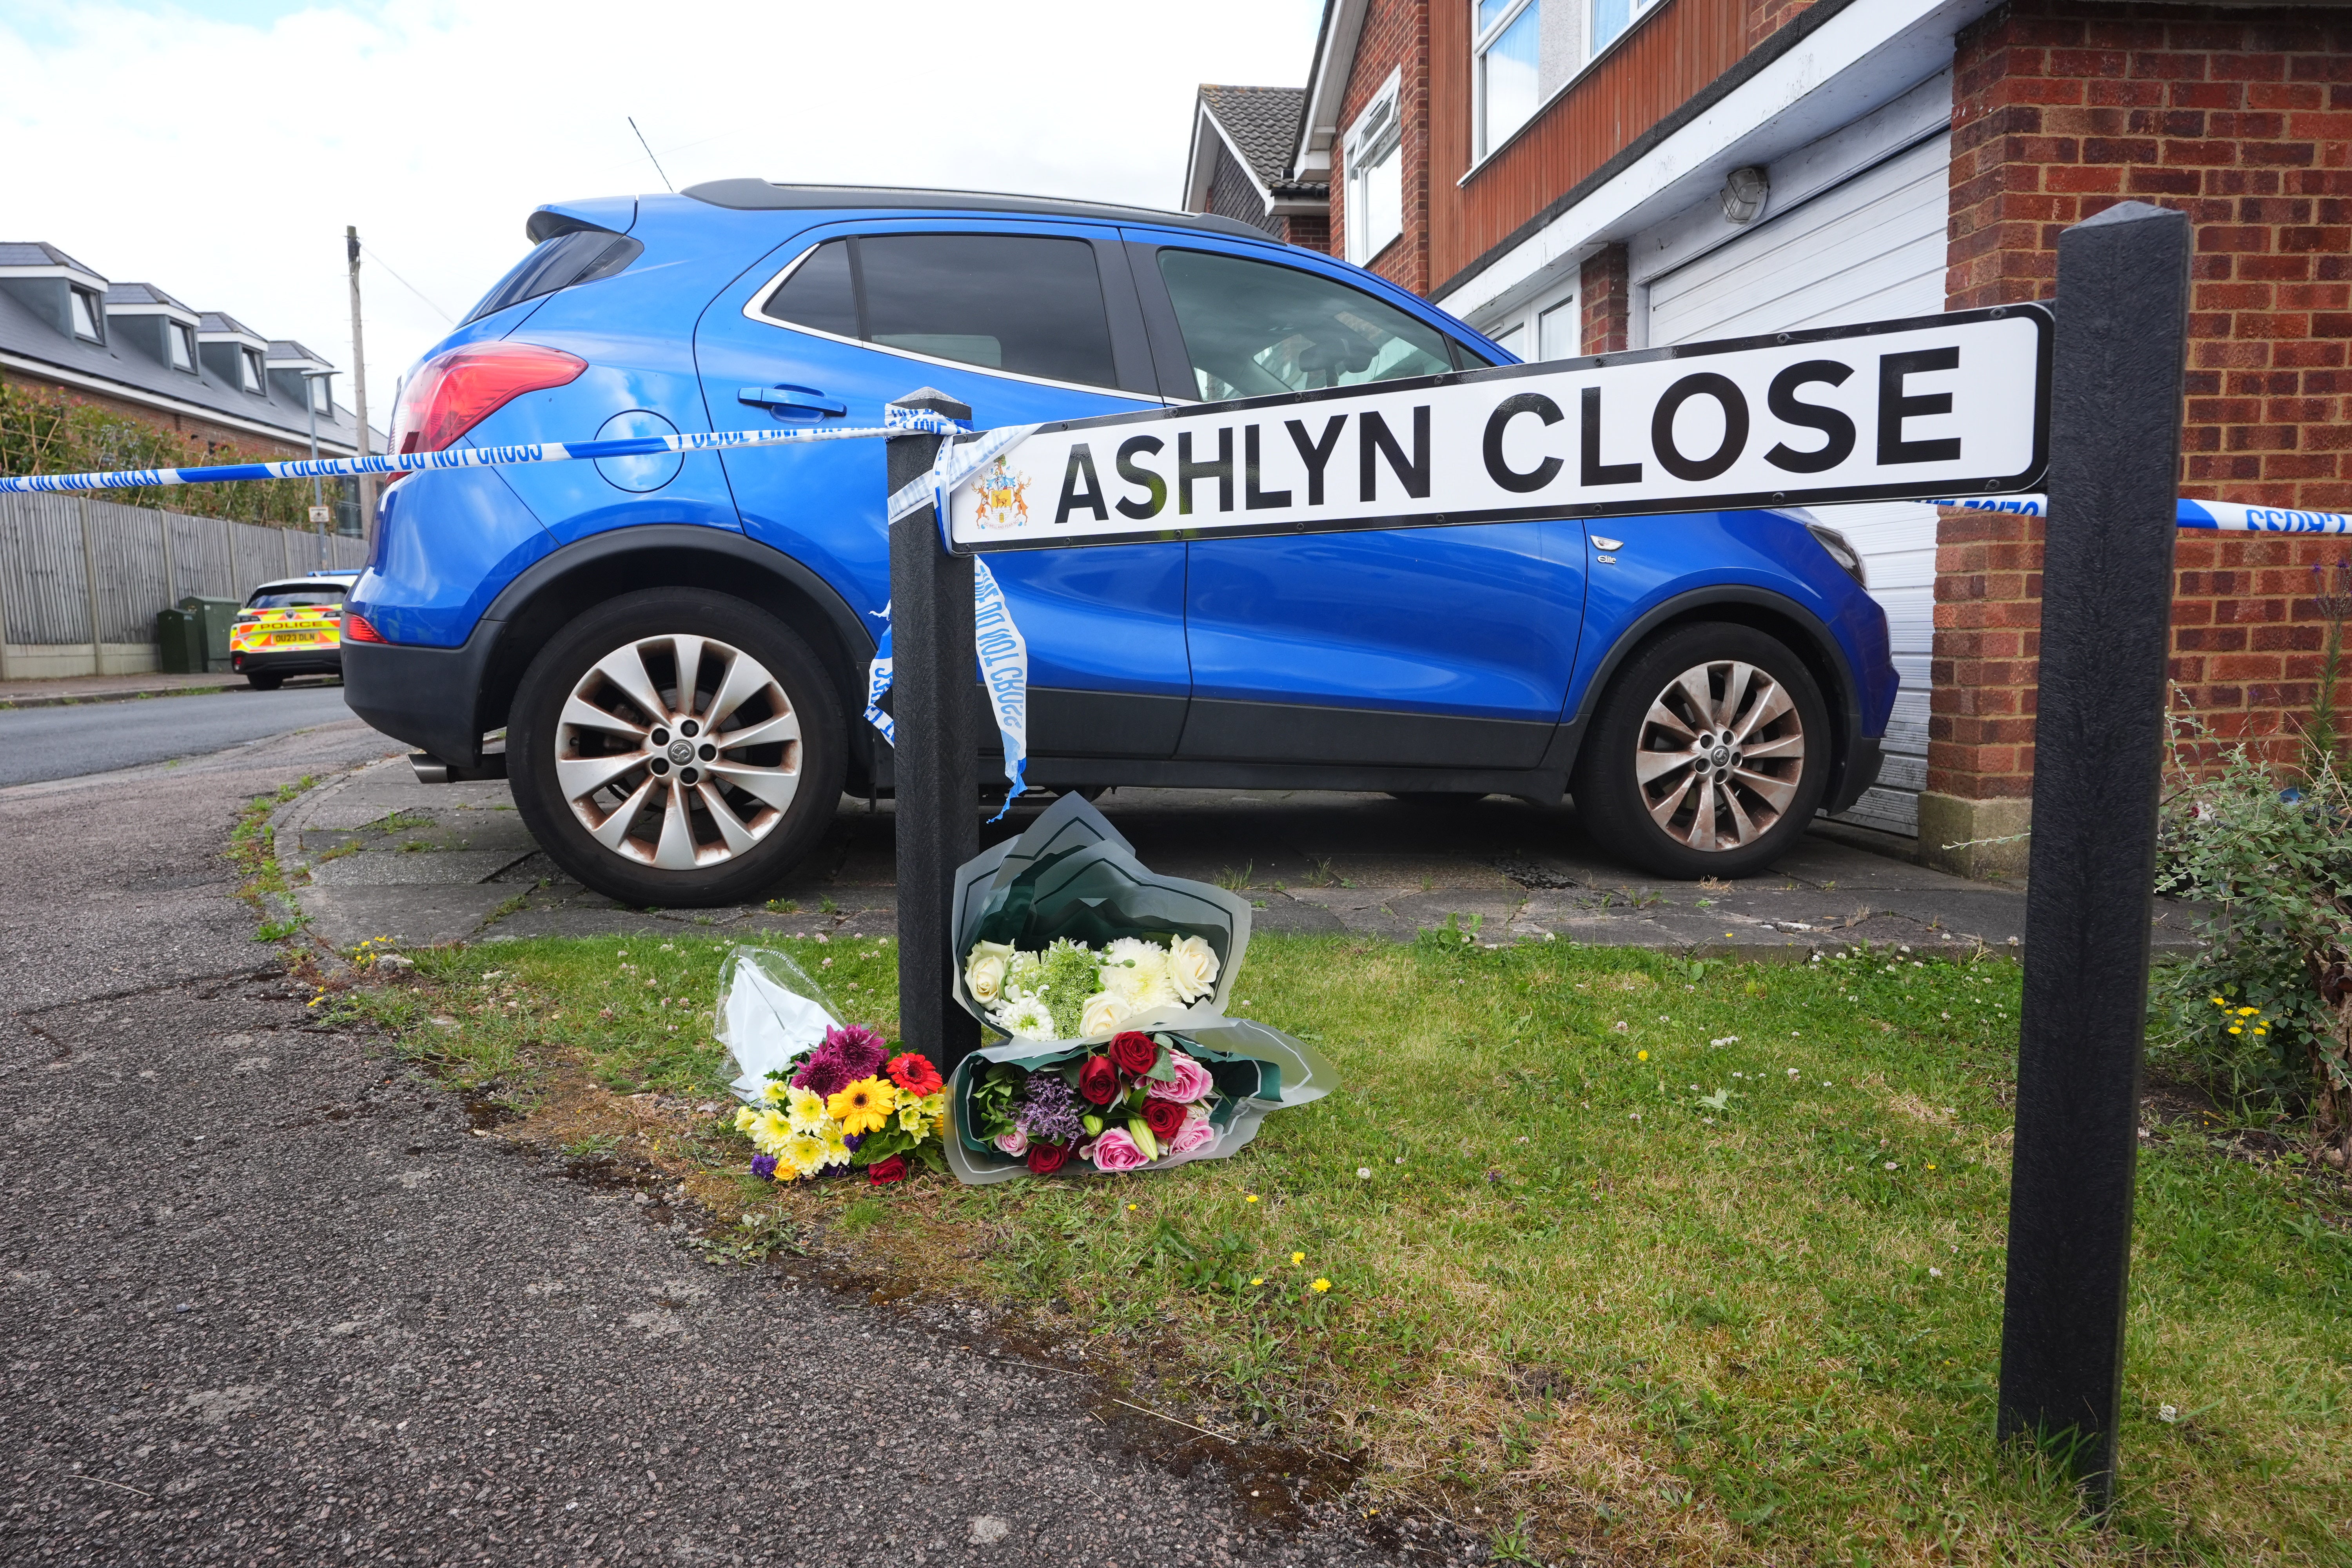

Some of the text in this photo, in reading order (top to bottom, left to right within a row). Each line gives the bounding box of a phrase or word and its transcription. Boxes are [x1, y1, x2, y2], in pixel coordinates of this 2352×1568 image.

[1055, 405, 1430, 524] ASHLYN
[1483, 346, 1962, 493] CLOSE
[351, 456, 395, 473] LINE
[1597, 555, 1616, 564] Elite
[260, 621, 323, 630] POLICE
[276, 633, 297, 642] OU23
